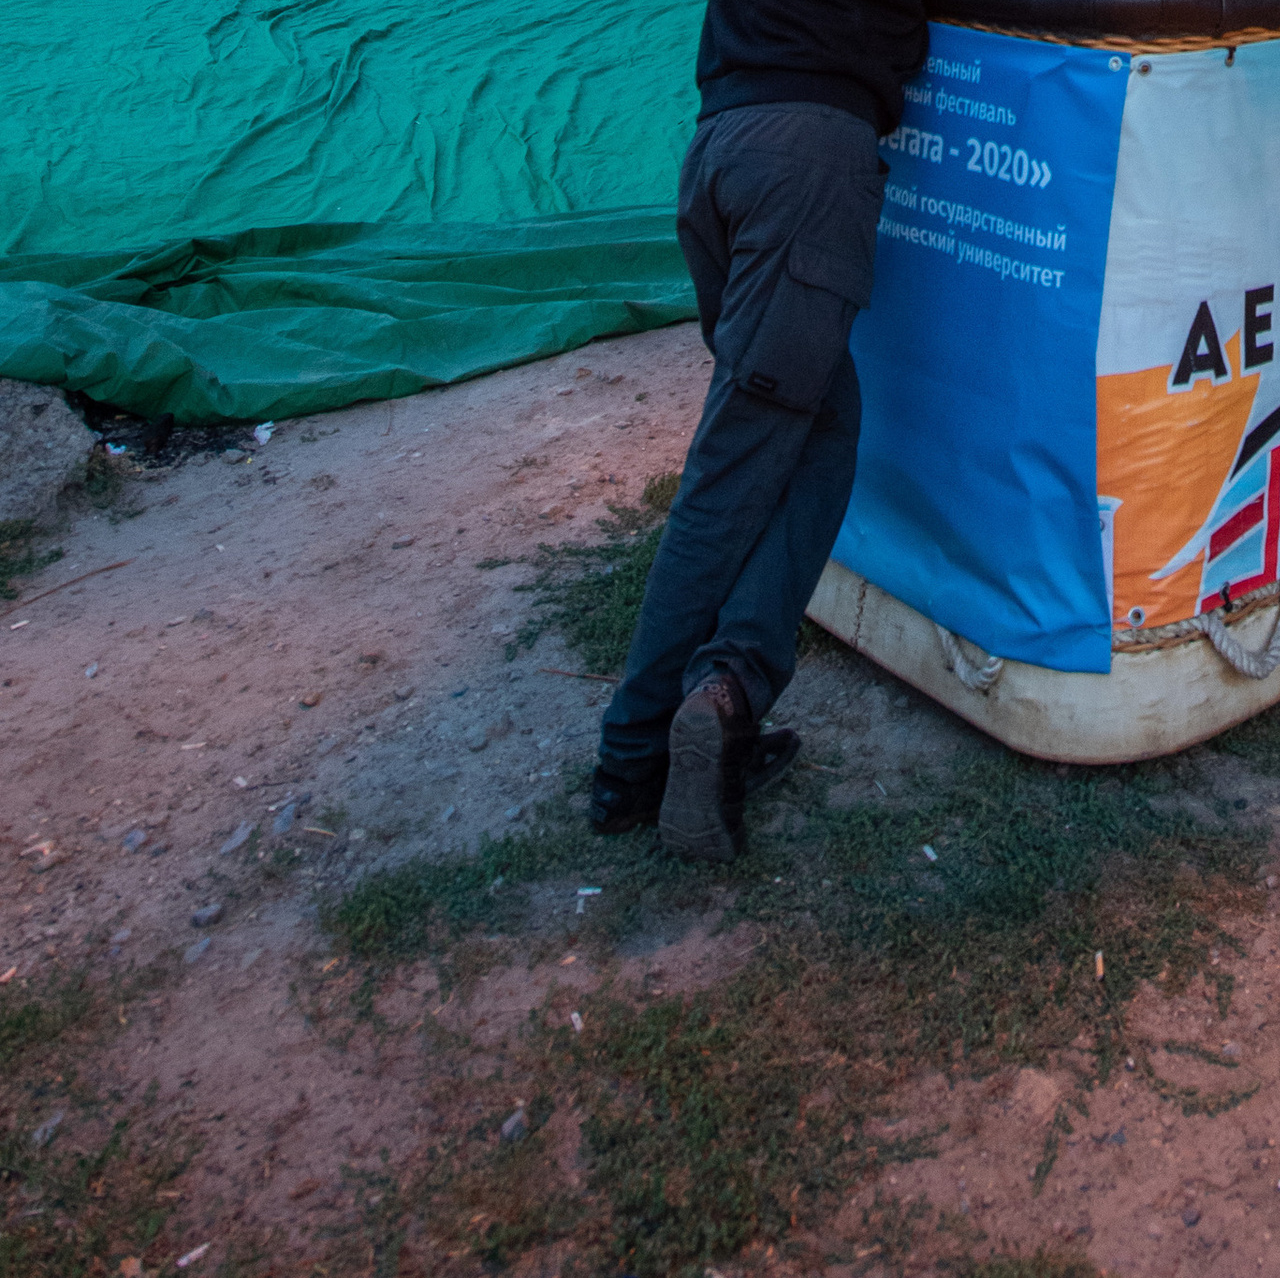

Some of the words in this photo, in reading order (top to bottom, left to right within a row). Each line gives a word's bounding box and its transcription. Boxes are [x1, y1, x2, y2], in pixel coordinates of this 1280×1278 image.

[922, 57, 981, 84] ельный
[935, 87, 1017, 126] фестиваль
[879, 126, 943, 164] егата
[920, 195, 1066, 252] государственный
[957, 239, 1065, 289] университет
